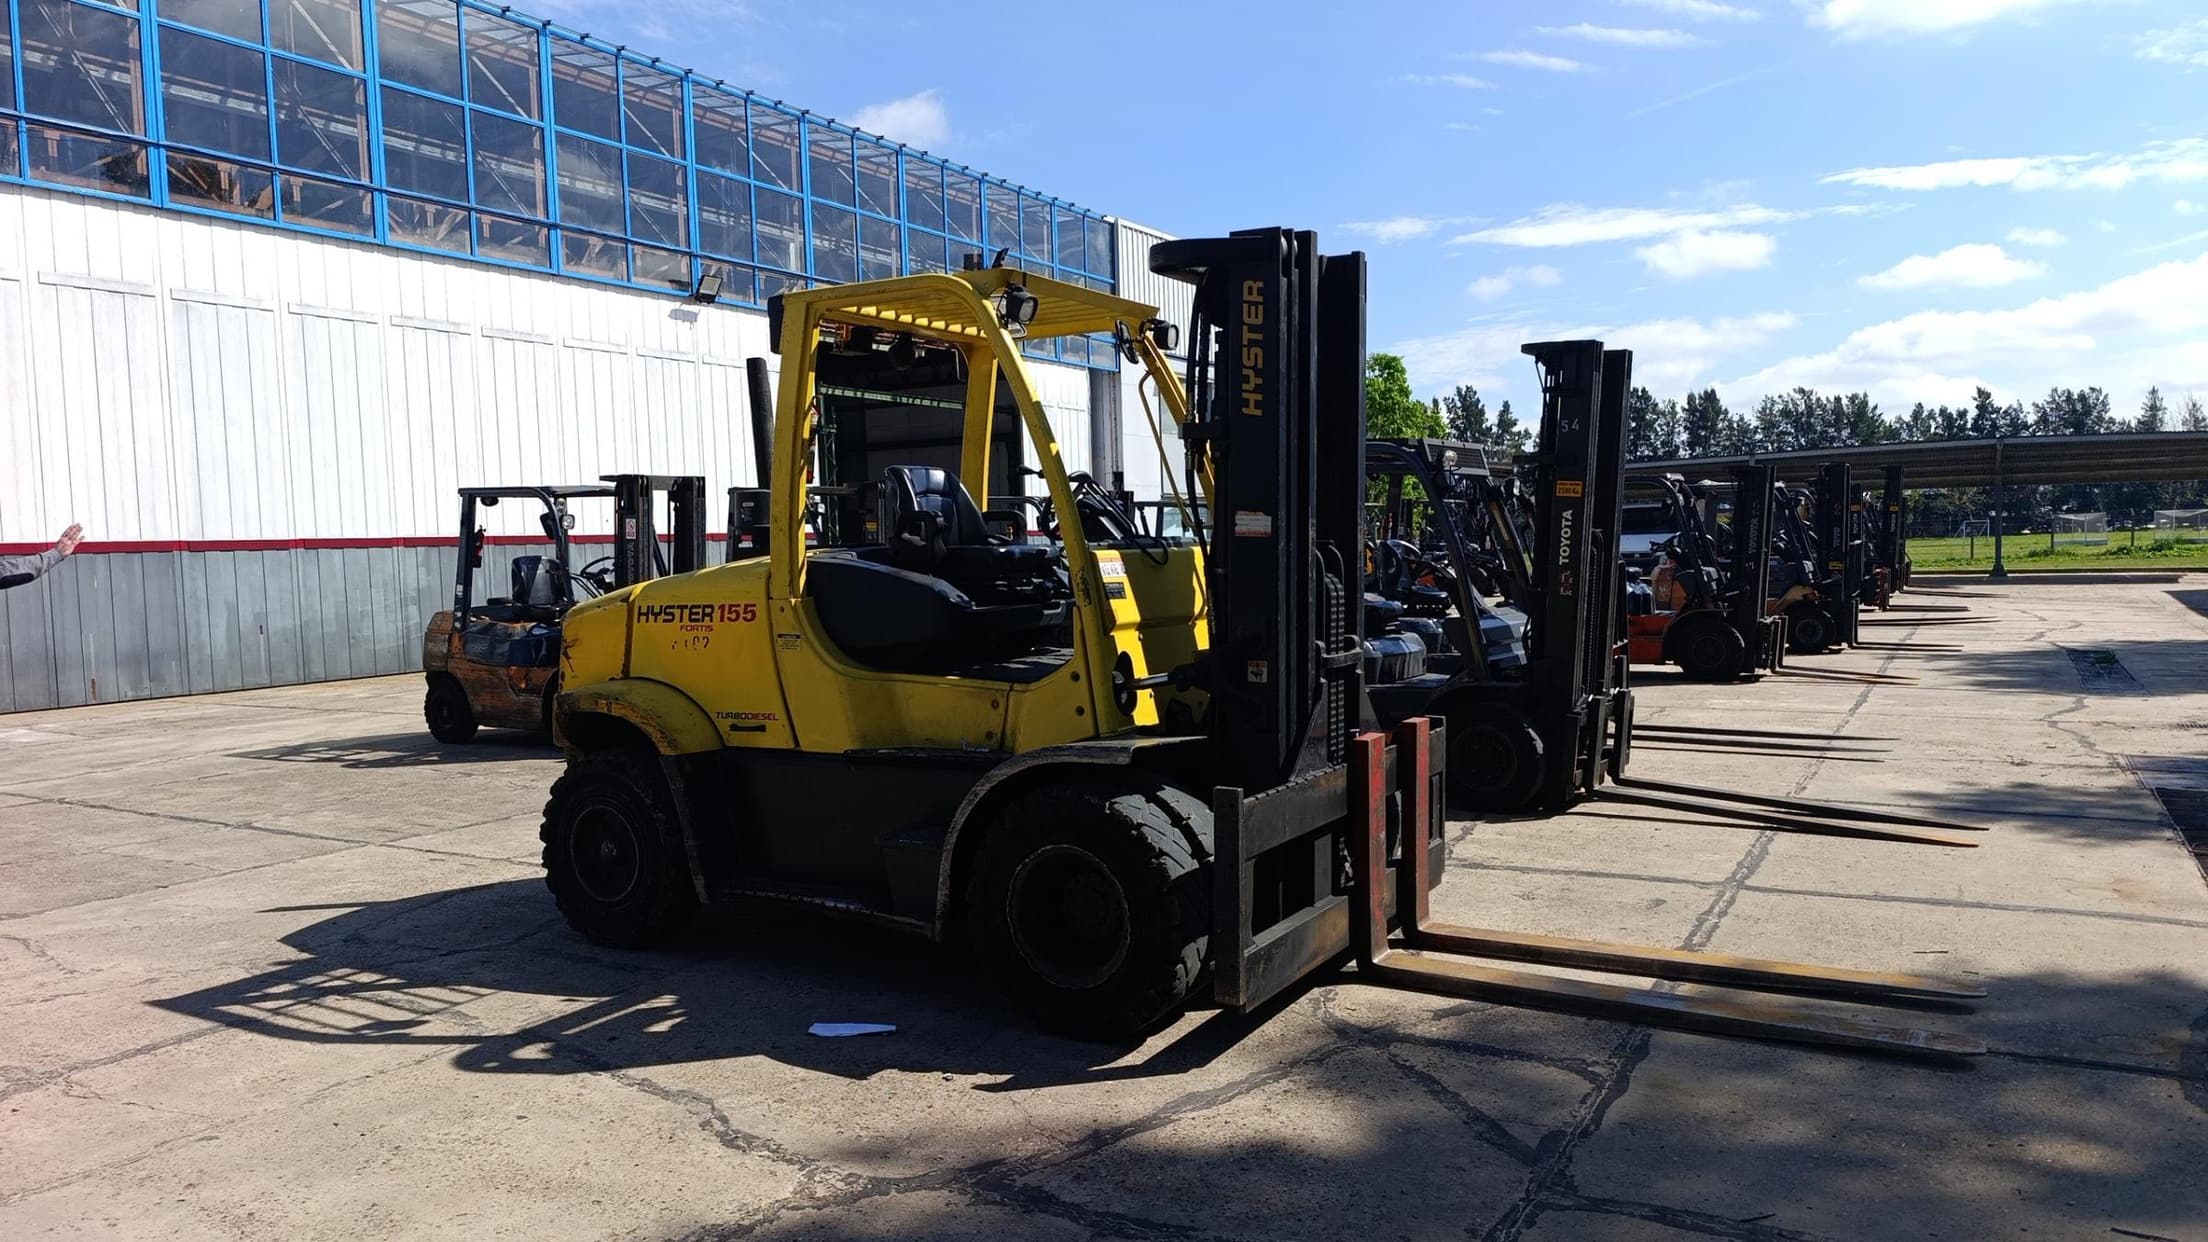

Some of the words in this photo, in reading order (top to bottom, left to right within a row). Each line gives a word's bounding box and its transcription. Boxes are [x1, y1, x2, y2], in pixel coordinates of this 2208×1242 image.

[1241, 279, 1264, 416] HYSTER
[1561, 417, 1580, 433] 54
[1558, 509, 1573, 565] TOYOTA
[636, 604, 714, 624] HYSTER
[718, 603, 757, 623] 155
[680, 624, 714, 632] FORTIS
[715, 711, 779, 721] TURBODIESEL
